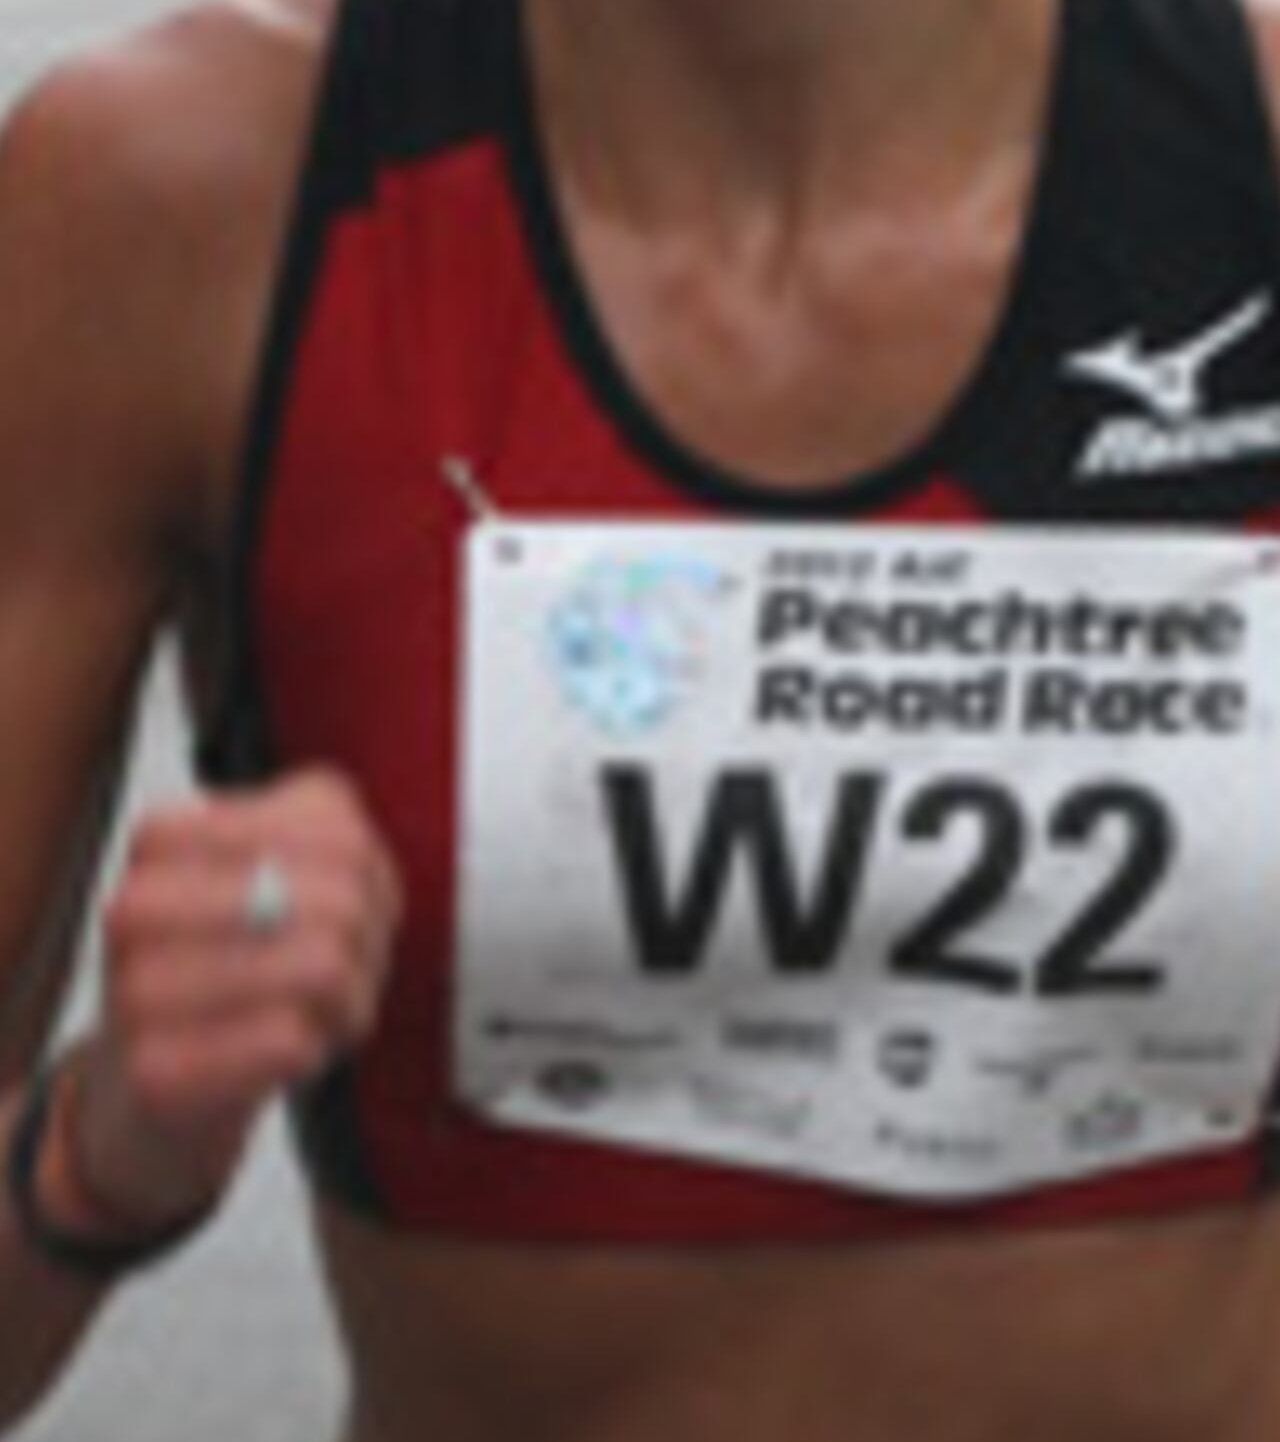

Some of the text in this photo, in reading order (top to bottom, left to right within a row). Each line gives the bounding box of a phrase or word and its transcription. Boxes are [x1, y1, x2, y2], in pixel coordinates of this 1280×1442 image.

[757, 588, 1246, 656] Peachtree
[756, 666, 1246, 734] Road Race
[598, 760, 1178, 999] W22
